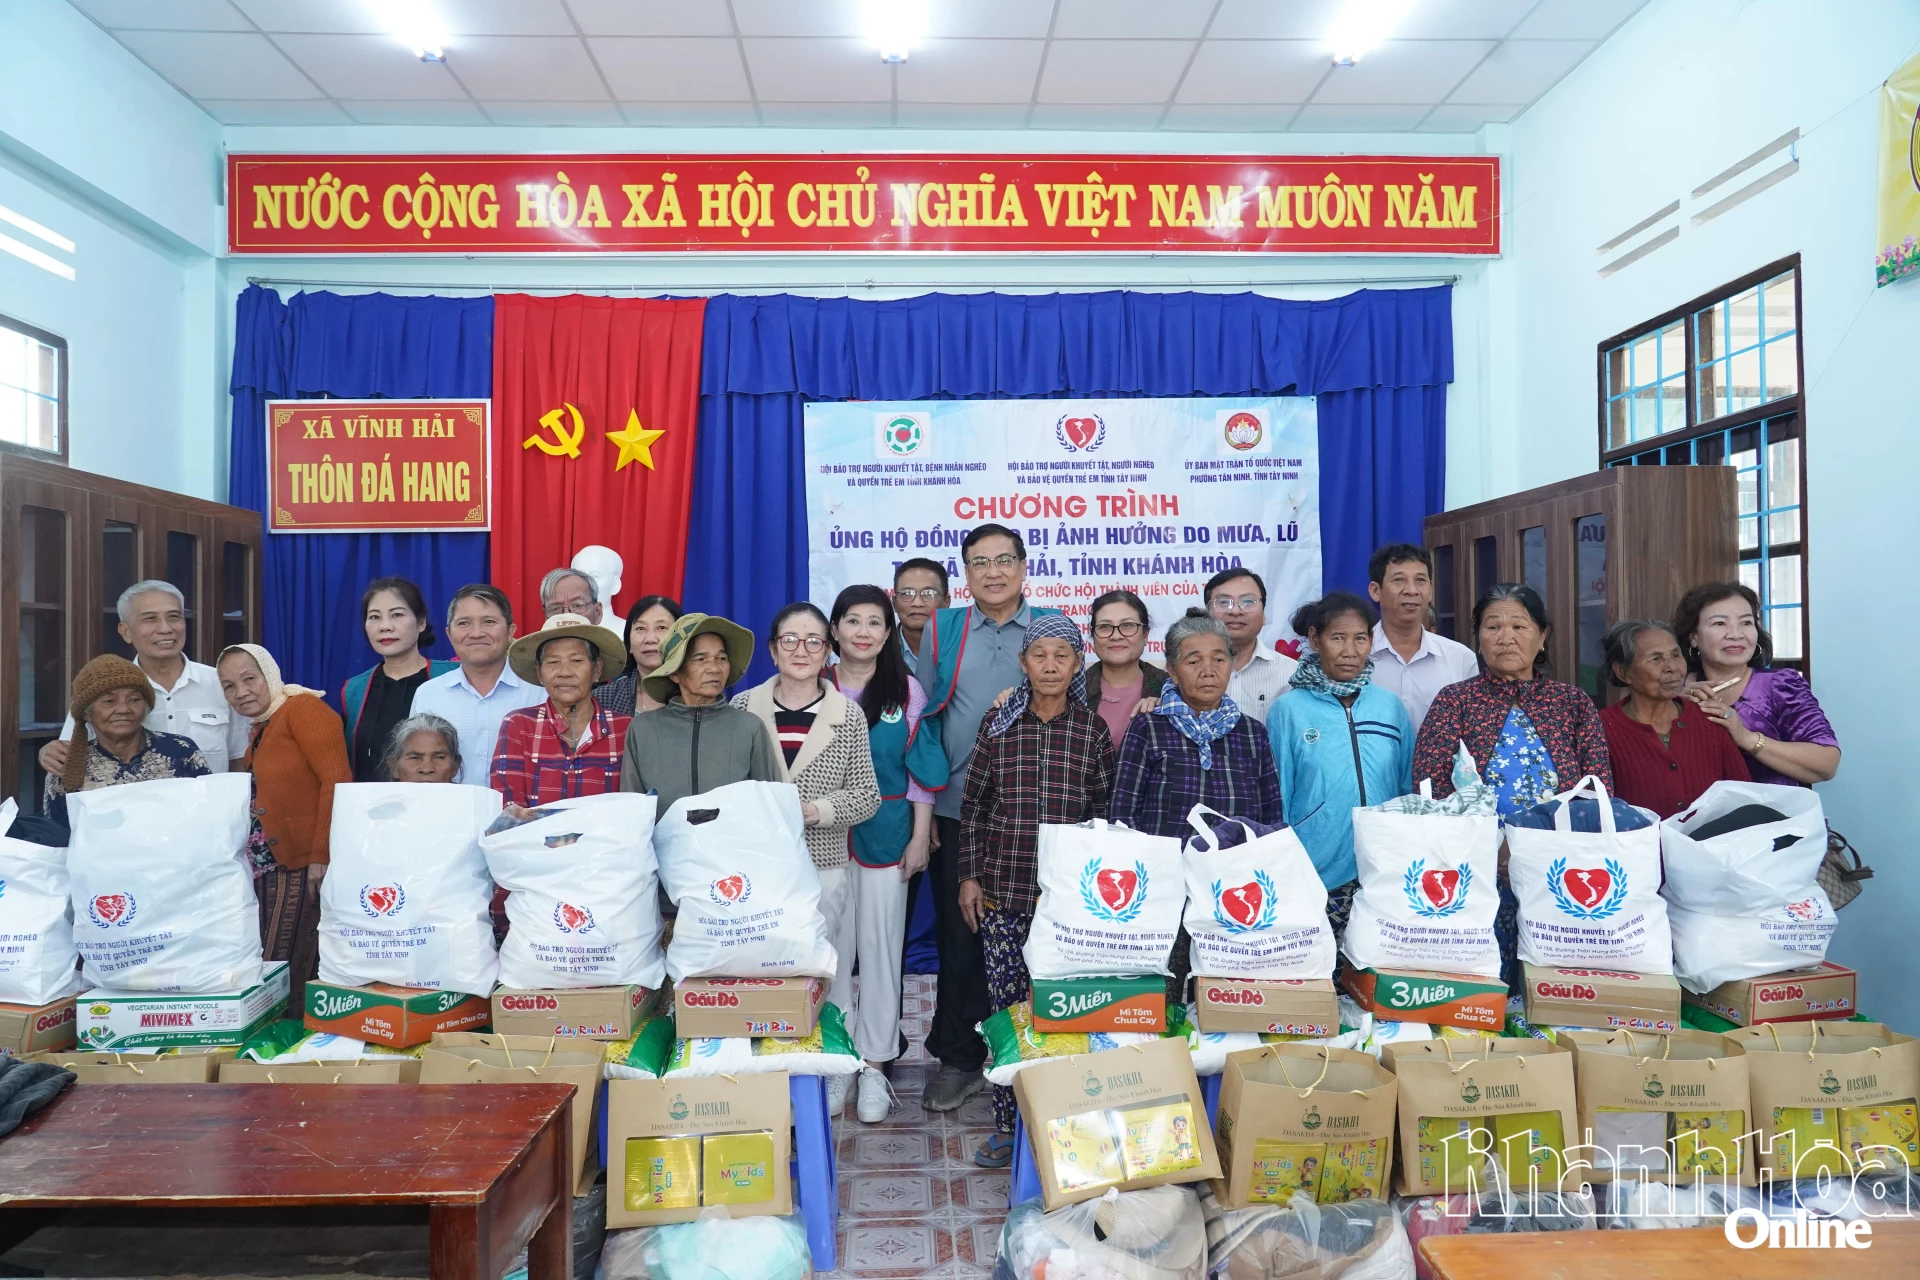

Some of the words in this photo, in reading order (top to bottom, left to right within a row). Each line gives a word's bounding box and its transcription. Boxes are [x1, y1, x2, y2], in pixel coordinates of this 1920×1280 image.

[253, 172, 371, 229] NƯỚC
[383, 172, 500, 239] CỘNG
[516, 171, 611, 229] HÒA
[621, 173, 686, 229] XÃ
[698, 171, 774, 238] HỘI
[788, 166, 876, 229] CHỦ
[891, 173, 1028, 228] NGHĨA
[1035, 171, 1137, 238] VIỆT
[1149, 184, 1244, 228] NAM
[1256, 172, 1372, 228] MUÔN
[1384, 173, 1478, 229] NĂM
[302, 416, 335, 439] XÃ
[343, 415, 403, 438] VĨNH
[412, 413, 455, 438] HẢI
[833, 463, 847, 473] BẢO
[848, 464, 861, 474] TRỢ
[862, 462, 883, 473] NGƯỜI
[884, 461, 909, 473] KHUYẾT
[925, 462, 943, 473] BỆNH
[944, 461, 963, 472] NHÂN
[965, 460, 987, 471] NGHÈO
[1008, 461, 1018, 471] HỘI
[1019, 460, 1034, 471] BẢO
[1035, 461, 1049, 472] TRỢ
[1049, 459, 1070, 471] NGƯỜI
[1071, 458, 1096, 470] KHUYẾT
[1098, 459, 1110, 471] TẬT,
[1111, 458, 1132, 470] NGƯỜI
[1133, 458, 1154, 470] NGHÈO
[1195, 461, 1209, 470] BAN
[1210, 459, 1225, 470] MẶT
[1226, 459, 1244, 470] TRẬN
[1245, 457, 1254, 468] TỔ
[1255, 456, 1271, 468] QUỐC
[1273, 457, 1286, 469] VIỆT
[1287, 458, 1302, 467] NAM
[288, 454, 353, 504] THÔN
[361, 453, 395, 503] ĐÁ
[403, 461, 470, 502] HANG
[847, 476, 856, 487] VÀ
[857, 475, 880, 487] QUYỀN
[894, 477, 905, 486] EM
[923, 475, 946, 486] KHÁNH
[947, 475, 961, 485] HÒA
[1017, 474, 1027, 484] VÀ
[1029, 473, 1041, 484] BẢO
[1042, 473, 1051, 484] VỆ
[1052, 472, 1073, 484] QUYỀN
[1075, 472, 1087, 483] TRẺ
[1089, 474, 1100, 483] EM
[1101, 472, 1115, 483] TỈNH
[1117, 472, 1129, 483] TÂY
[1131, 474, 1147, 483] NINH
[1190, 472, 1217, 483] PHƯỜNG
[1218, 471, 1232, 483] TÂN
[1232, 472, 1252, 483] NINH,
[1254, 470, 1268, 482] TỈNH
[1269, 471, 1282, 482] TÂY
[1283, 472, 1299, 481] NINH
[954, 493, 1087, 520] CHƯƠNG
[1096, 488, 1180, 518] TRÌNH
[830, 525, 877, 549] ỦNG
[881, 527, 908, 552] HỘ
[1029, 528, 1049, 550] BỊ
[1056, 522, 1099, 545] ẢNH
[1106, 521, 1177, 545] HƯỞNG
[1184, 526, 1210, 544] DO
[1217, 524, 1271, 546] MƯA,
[1277, 521, 1299, 542] LŨ
[1069, 553, 1117, 576] TỈNH
[1123, 553, 1194, 575] KHÁNH
[1036, 582, 1071, 598] CHỨC
[1075, 582, 1096, 600] HỘI
[1143, 581, 1169, 596] VIÊN
[1172, 579, 1199, 596] CỦA
[1407, 984, 1455, 1007] Miền
[127, 1004, 165, 1012] VEGETARIAN
[166, 1003, 192, 1011] INSTANT
[326, 994, 361, 1017] Miền
[1066, 990, 1112, 1017] Miền
[1461, 1005, 1472, 1013] Mì
[1474, 1007, 1494, 1016] Tôm
[1806, 1001, 1823, 1011] Tôm
[1825, 999, 1834, 1010] và
[1836, 997, 1849, 1008] Gà
[1120, 1008, 1130, 1016] Mì
[1133, 1008, 1152, 1016] Tôm
[1454, 1012, 1478, 1021] Chua
[1479, 1015, 1497, 1025] Cay
[139, 1012, 194, 1028] MIVIMEX
[365, 1017, 374, 1026] Mì
[375, 1018, 391, 1029] Tôm
[746, 1021, 769, 1034] Thịt
[771, 1019, 795, 1032] Bằm
[1114, 1016, 1137, 1024] Chua
[1139, 1017, 1157, 1026] Cay
[1607, 1016, 1627, 1027] Tôm
[1629, 1018, 1653, 1029] Chua
[1656, 1020, 1675, 1032] Cay
[361, 1025, 380, 1036] Chua
[381, 1029, 394, 1039] Cay
[555, 1025, 576, 1037] Chay
[579, 1025, 597, 1035] Rau
[1267, 1022, 1283, 1033] Gà
[1306, 1024, 1329, 1035] Phở
[1107, 1071, 1144, 1090] DASAKHA
[1846, 1074, 1877, 1092] DASAKHA
[1486, 1084, 1520, 1100] DASAKHA
[1670, 1084, 1706, 1097] DASAKHA
[694, 1101, 730, 1117] DASAKHA
[1444, 1105, 1477, 1113] DASAKHA
[1327, 1116, 1360, 1129] DASAKHA
[1254, 1160, 1293, 1170] MyKids
